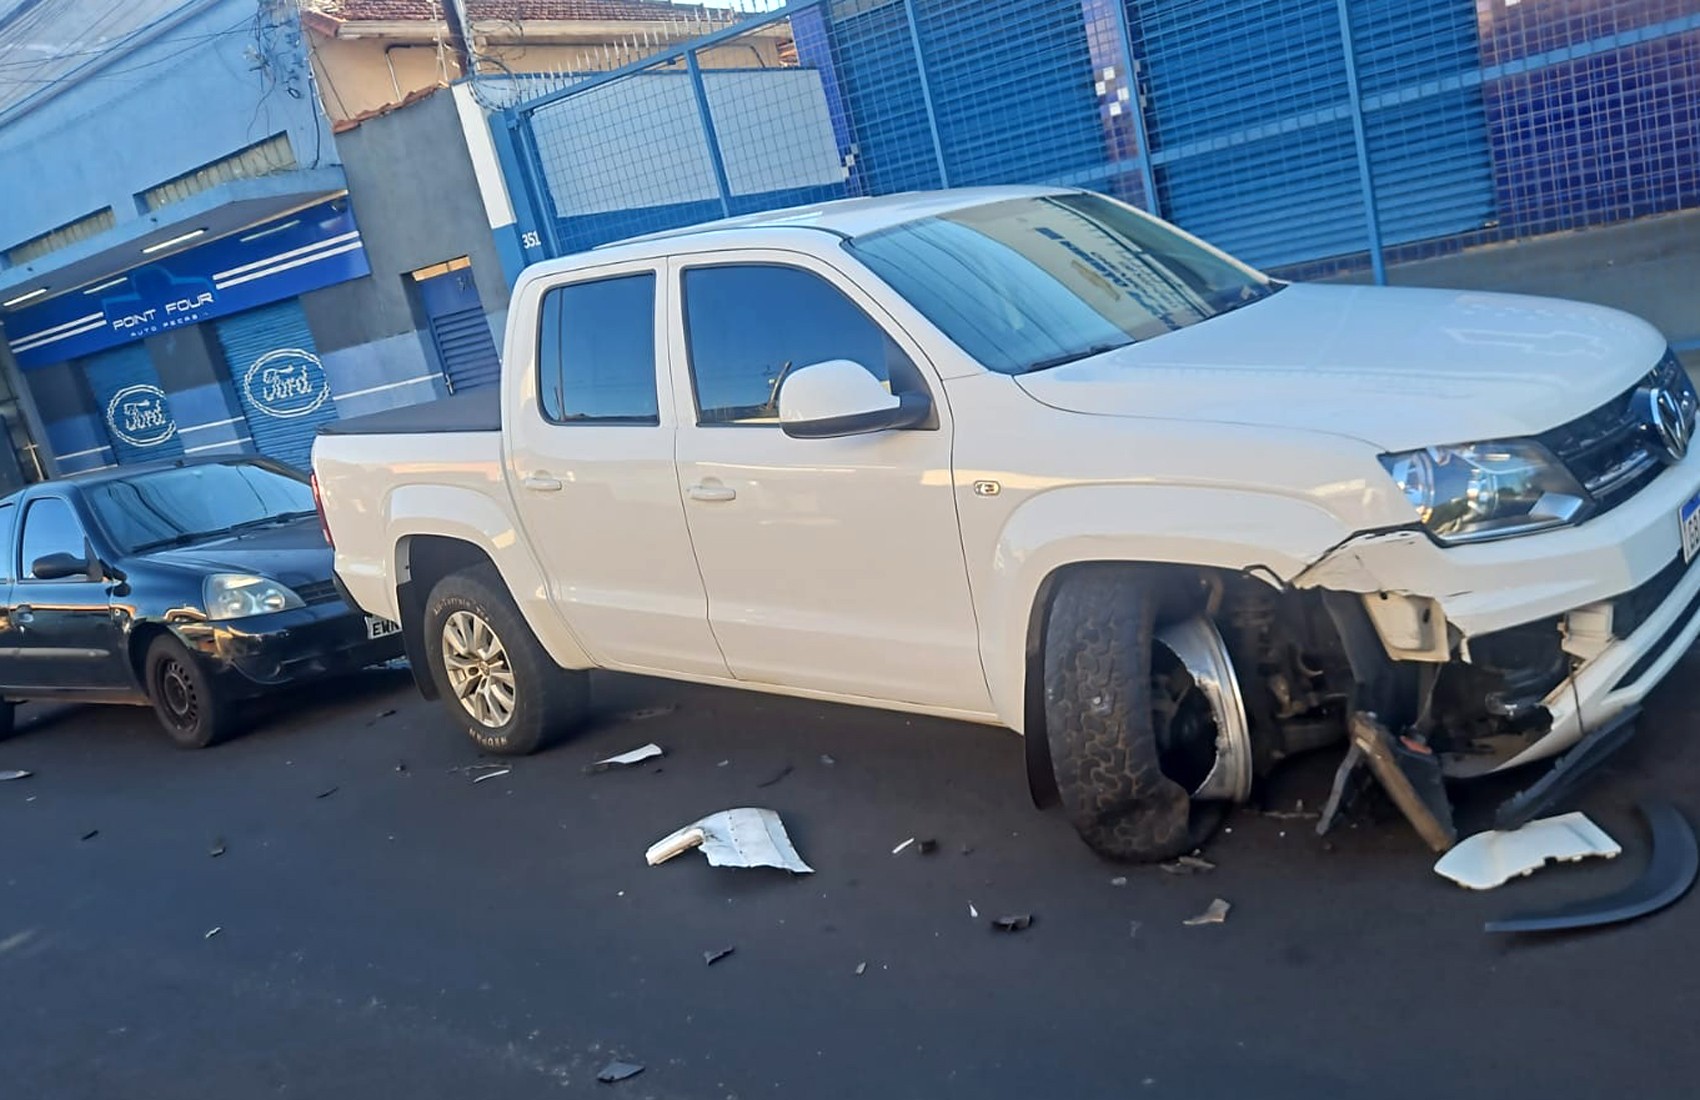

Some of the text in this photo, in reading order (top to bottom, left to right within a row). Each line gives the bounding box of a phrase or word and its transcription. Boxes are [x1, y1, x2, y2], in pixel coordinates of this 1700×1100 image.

[522, 230, 542, 249] 351
[165, 292, 214, 315] FOUR
[130, 325, 157, 337] AUTO
[263, 364, 312, 401] Ford
[123, 399, 166, 431] Ford
